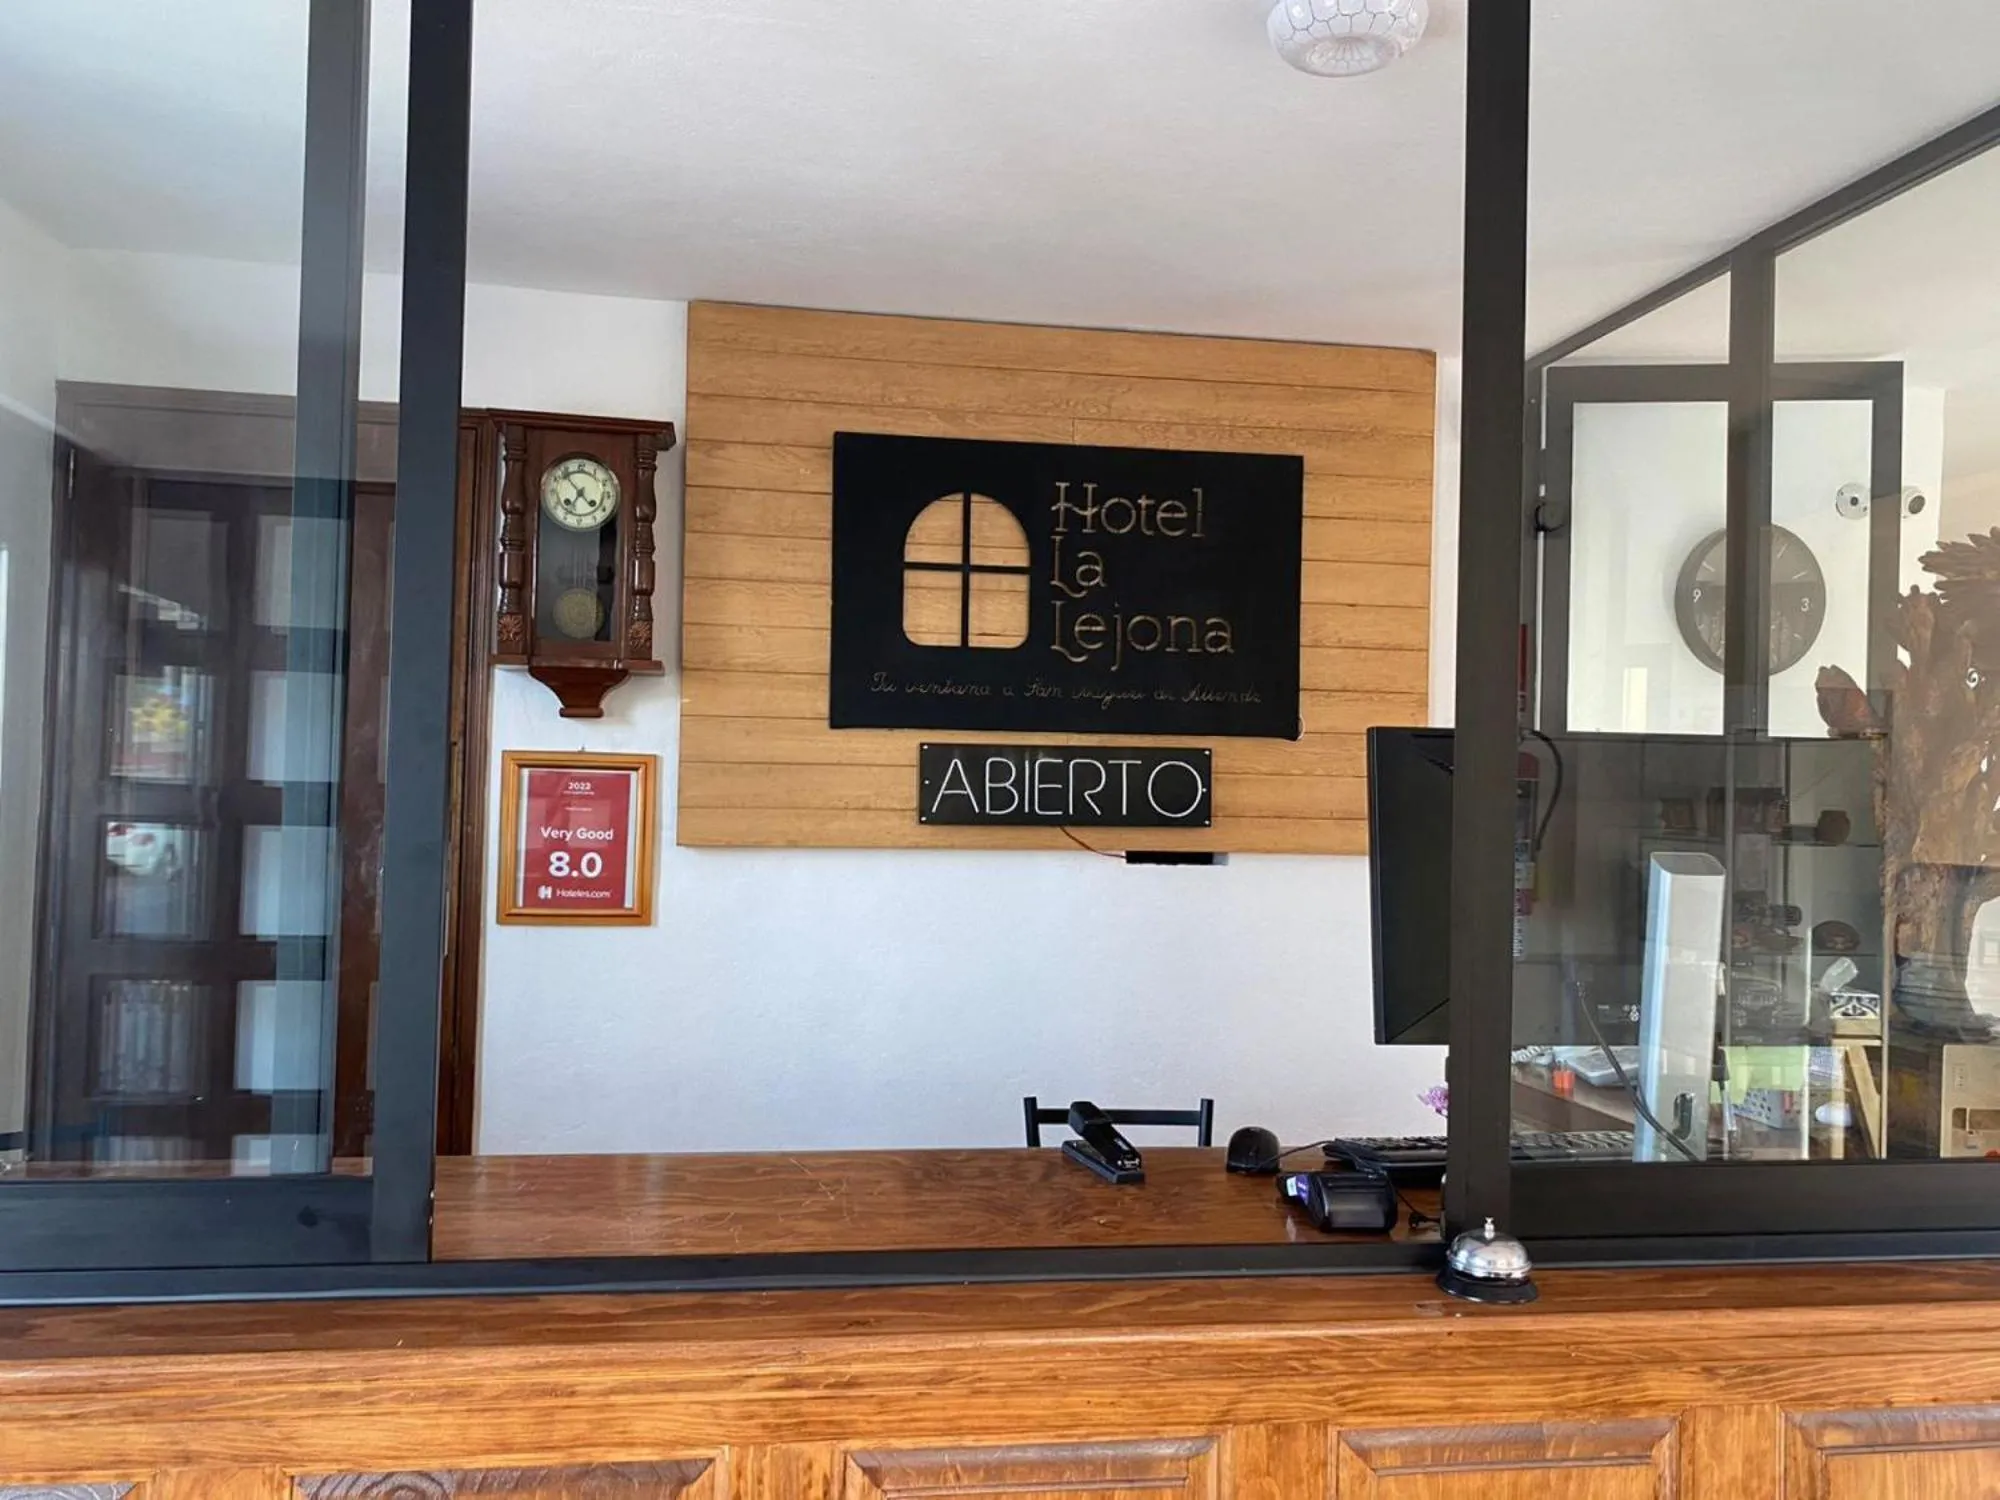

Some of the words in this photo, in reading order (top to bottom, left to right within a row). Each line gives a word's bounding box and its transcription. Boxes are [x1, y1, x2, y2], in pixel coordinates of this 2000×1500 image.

[1050, 481, 1206, 538] Hotel
[1050, 535, 1108, 598] La
[1050, 600, 1235, 672] Lejona
[904, 676, 993, 698] ventana
[1002, 684, 1016, 697] a
[931, 756, 1203, 818] ABIERTO
[540, 826, 574, 842] Very
[576, 828, 615, 841] Good
[548, 850, 603, 879] 8.0
